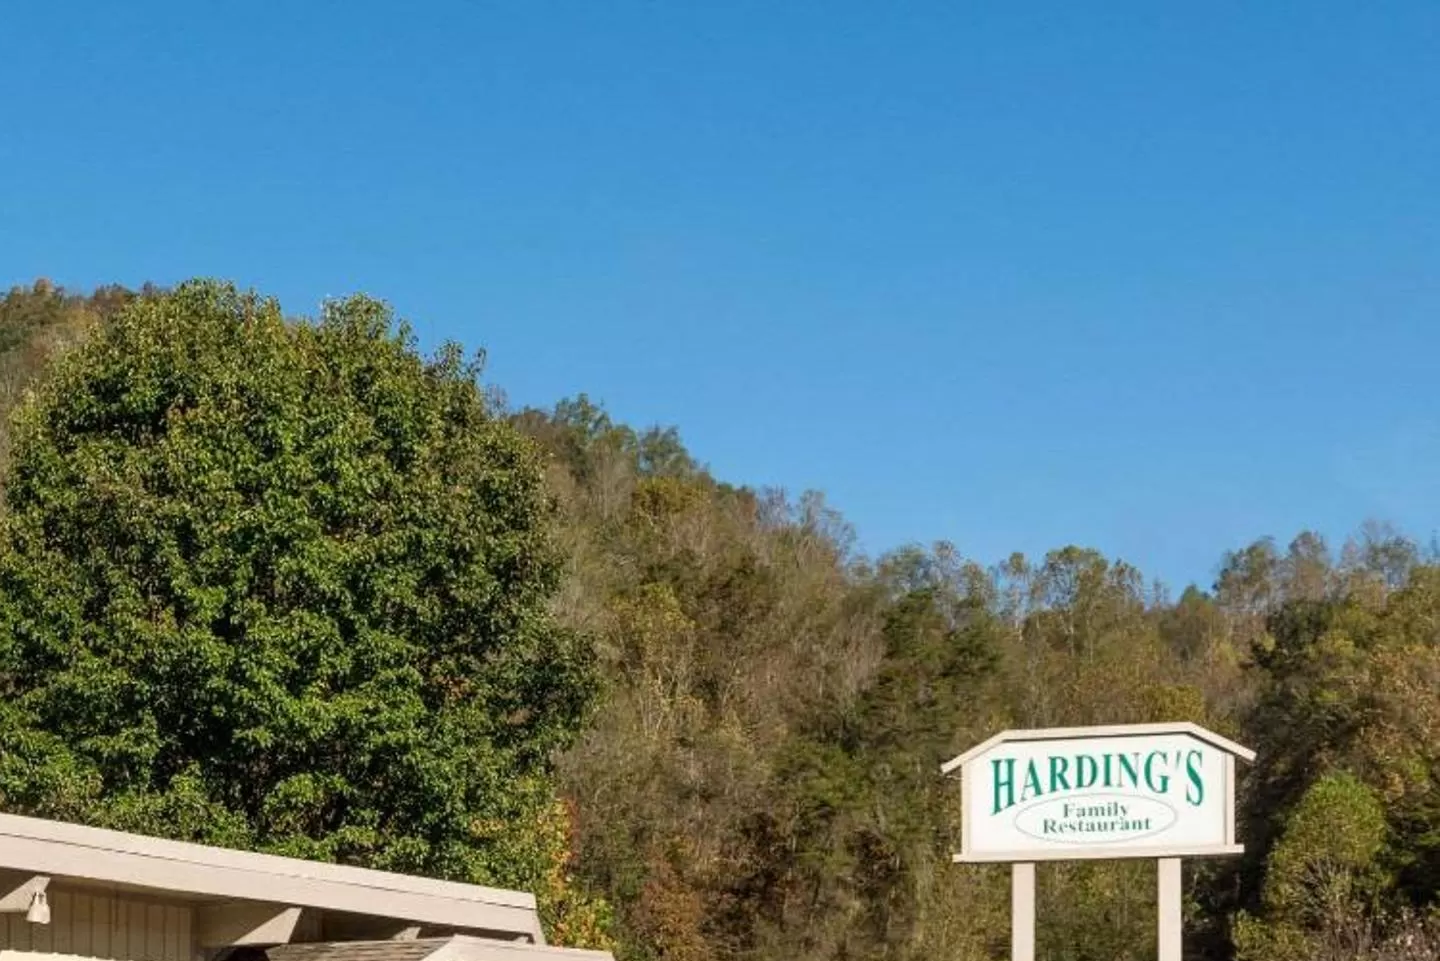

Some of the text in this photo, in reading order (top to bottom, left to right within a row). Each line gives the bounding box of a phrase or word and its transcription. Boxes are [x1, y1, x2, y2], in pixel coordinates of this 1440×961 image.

[989, 749, 1205, 817] HARDING'S
[1062, 802, 1130, 819] Family
[1042, 817, 1153, 835] Restaurant
